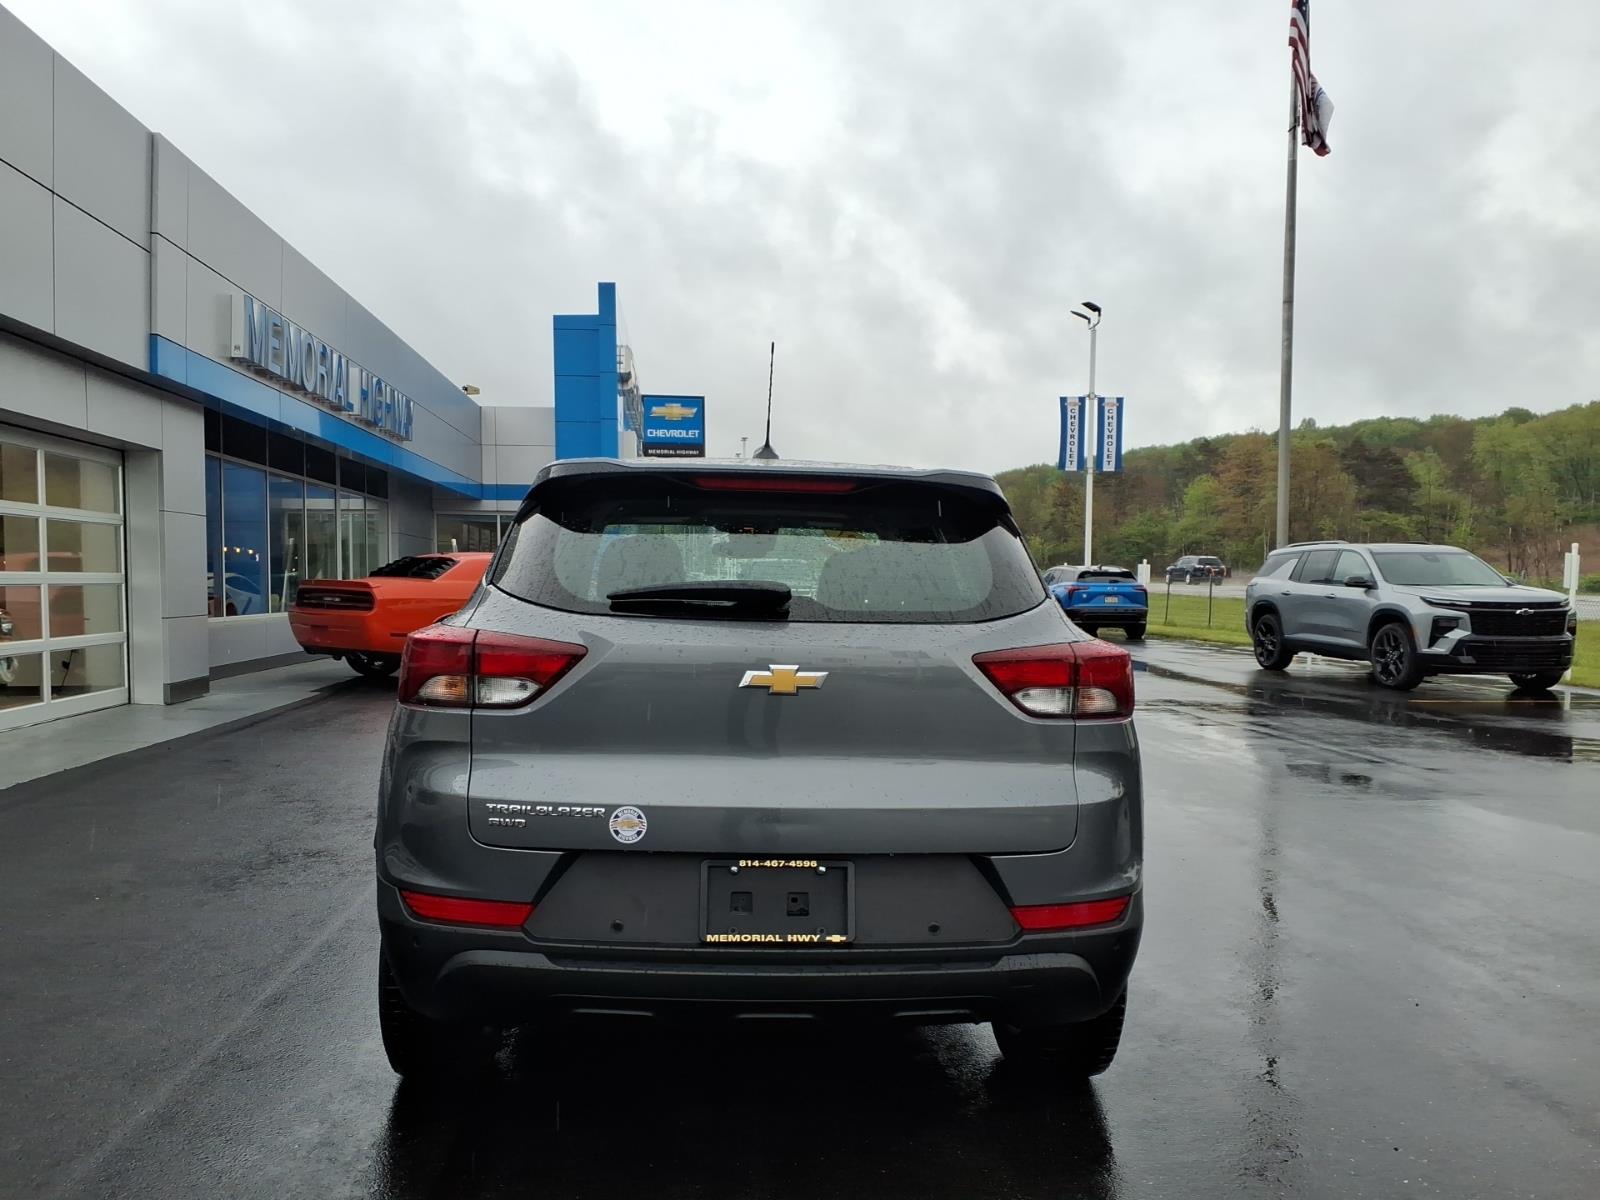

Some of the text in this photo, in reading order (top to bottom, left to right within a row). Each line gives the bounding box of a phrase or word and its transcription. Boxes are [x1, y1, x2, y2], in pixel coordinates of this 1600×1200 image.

[234, 294, 355, 413] MEMORIAL
[647, 429, 700, 438] CHEVROLET
[1068, 407, 1076, 466] CHEVROLET
[1106, 408, 1114, 466] CHEVROLET
[486, 803, 606, 817] TRAILBLAZER
[738, 859, 818, 868] 814-467-4596
[706, 934, 820, 943] MEMORIAL HWY
